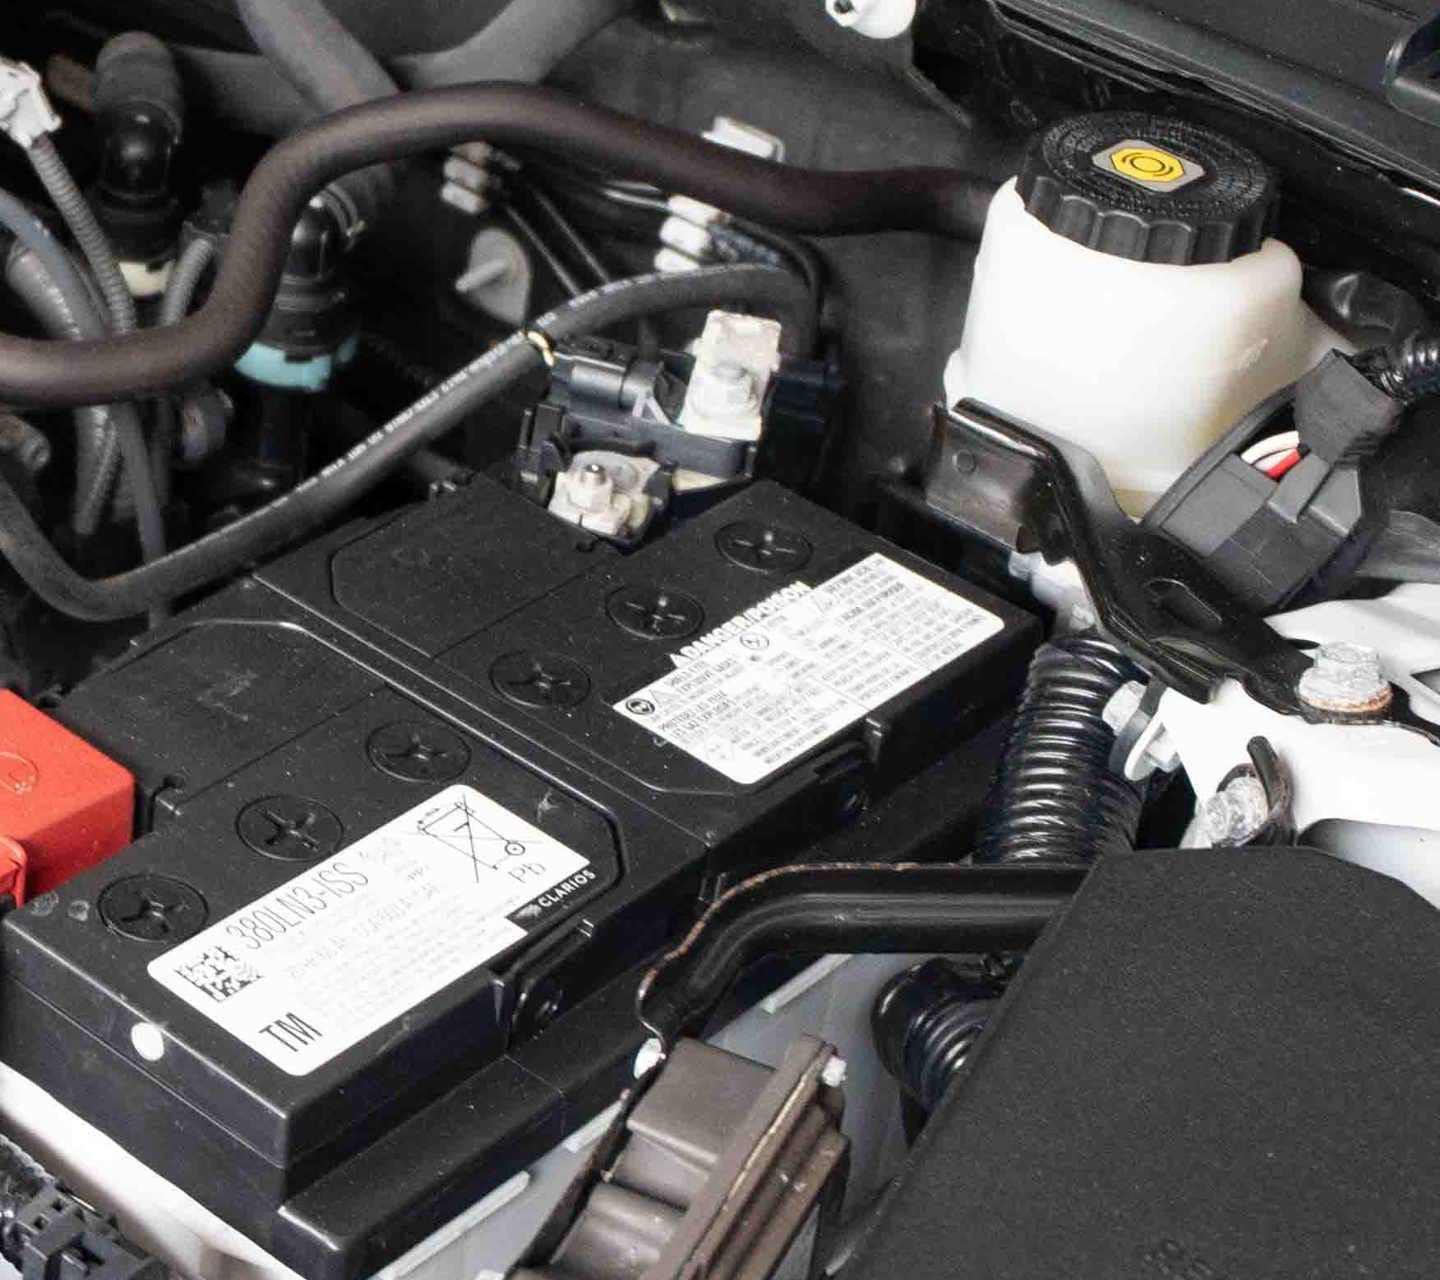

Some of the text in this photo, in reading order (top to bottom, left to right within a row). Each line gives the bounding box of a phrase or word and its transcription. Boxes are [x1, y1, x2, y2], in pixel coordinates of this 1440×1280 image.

[508, 861, 547, 885] Pb
[538, 869, 597, 908] CLARIOS
[225, 862, 370, 950] 380LN3-ISS
[258, 1011, 324, 1053] TM
